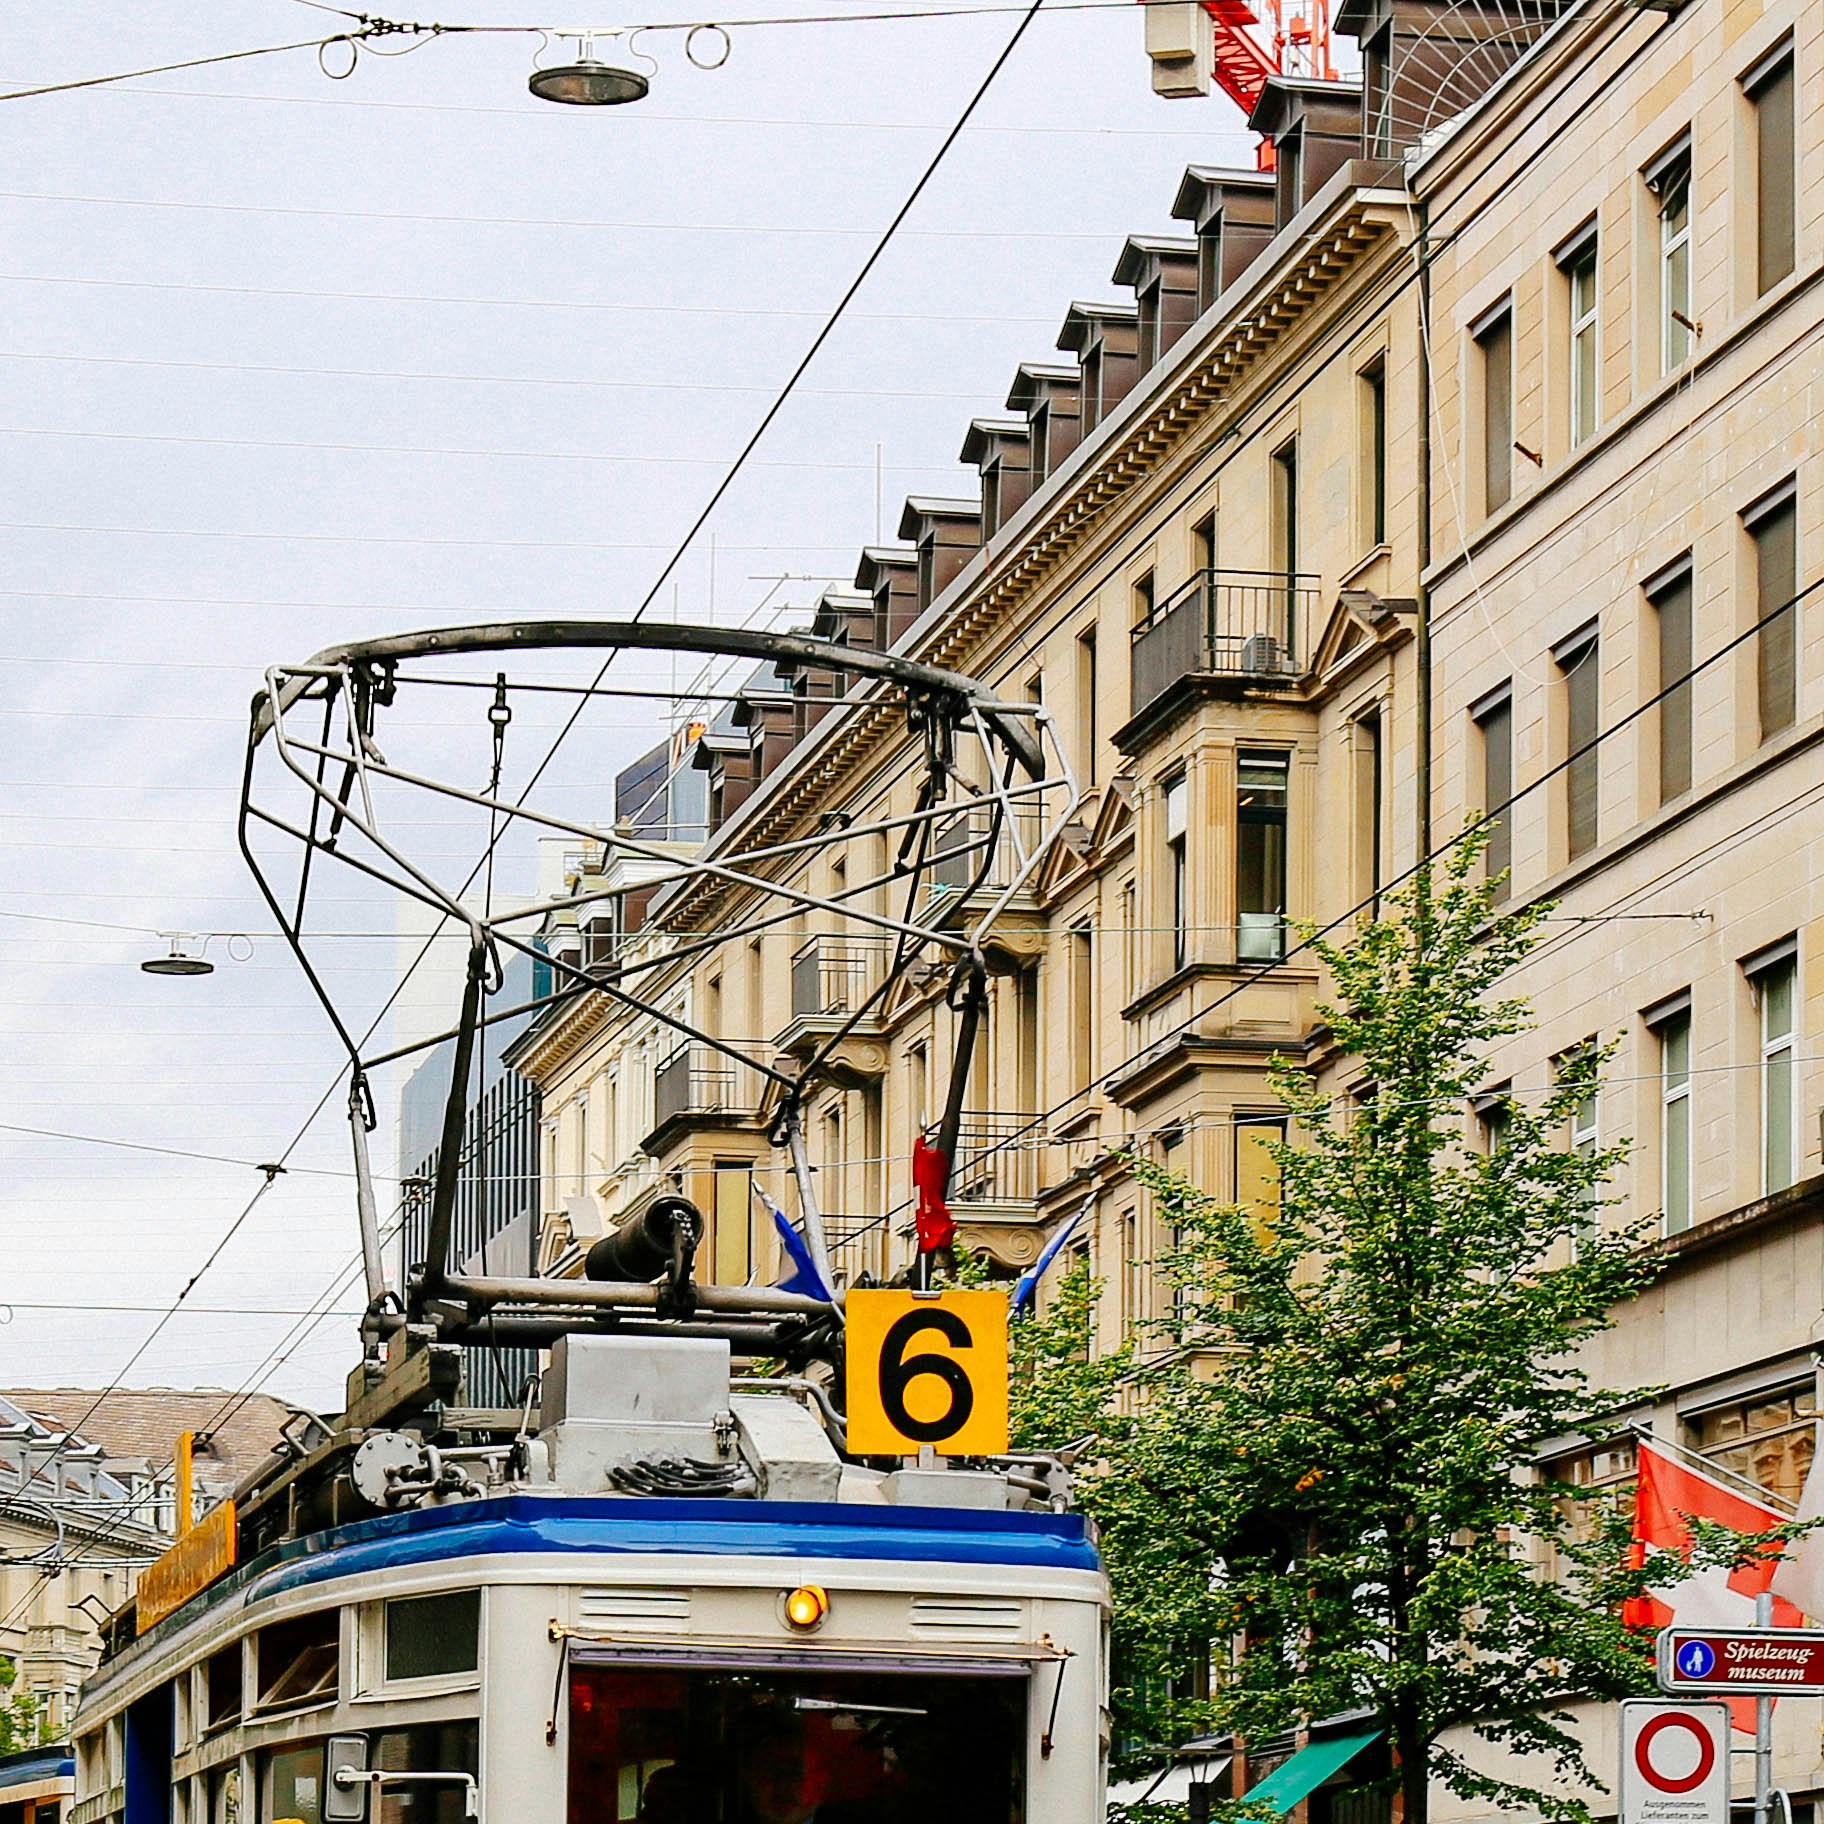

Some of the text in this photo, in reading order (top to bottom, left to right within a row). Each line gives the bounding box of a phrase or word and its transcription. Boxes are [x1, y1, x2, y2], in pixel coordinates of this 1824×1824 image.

[879, 1308, 974, 1443] 6
[1724, 1641, 1814, 1664] Spielzeug-
[1728, 1666, 1806, 1681] museum
